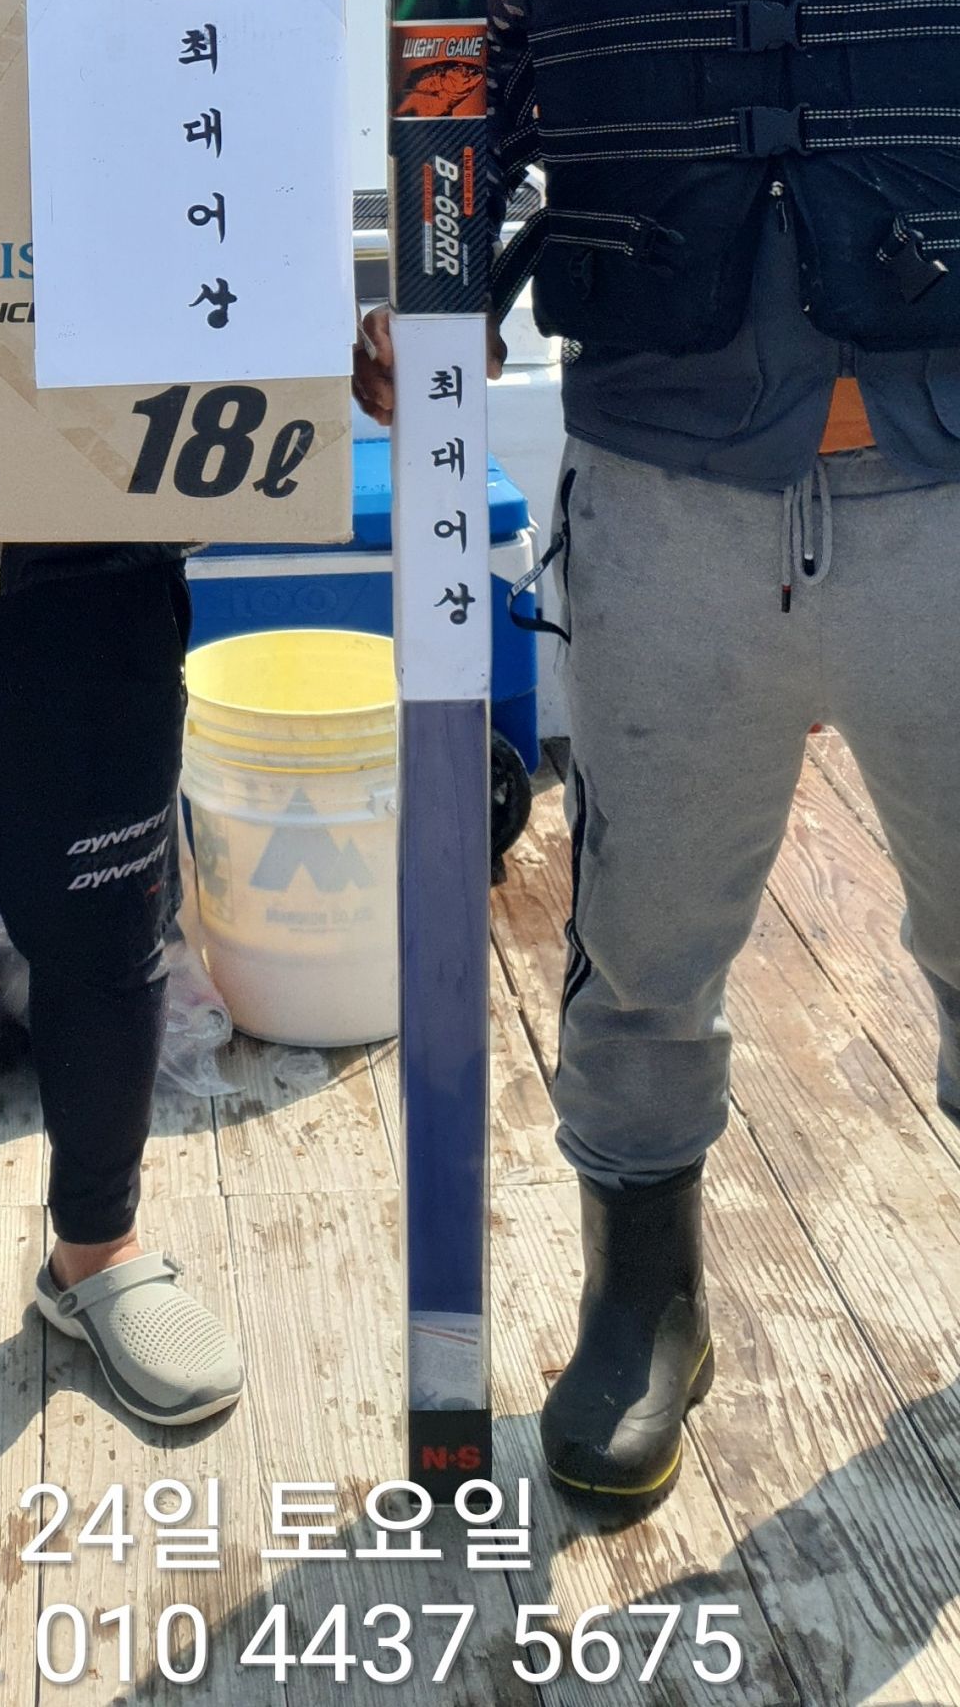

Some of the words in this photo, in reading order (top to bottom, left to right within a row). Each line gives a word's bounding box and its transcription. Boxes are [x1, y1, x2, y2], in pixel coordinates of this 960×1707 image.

[446, 36, 483, 57] GAME
[178, 23, 237, 330] 최대어상
[435, 155, 460, 276] B-66RR
[428, 365, 476, 625] 최대어상
[66, 803, 170, 856] DYNAFIT
